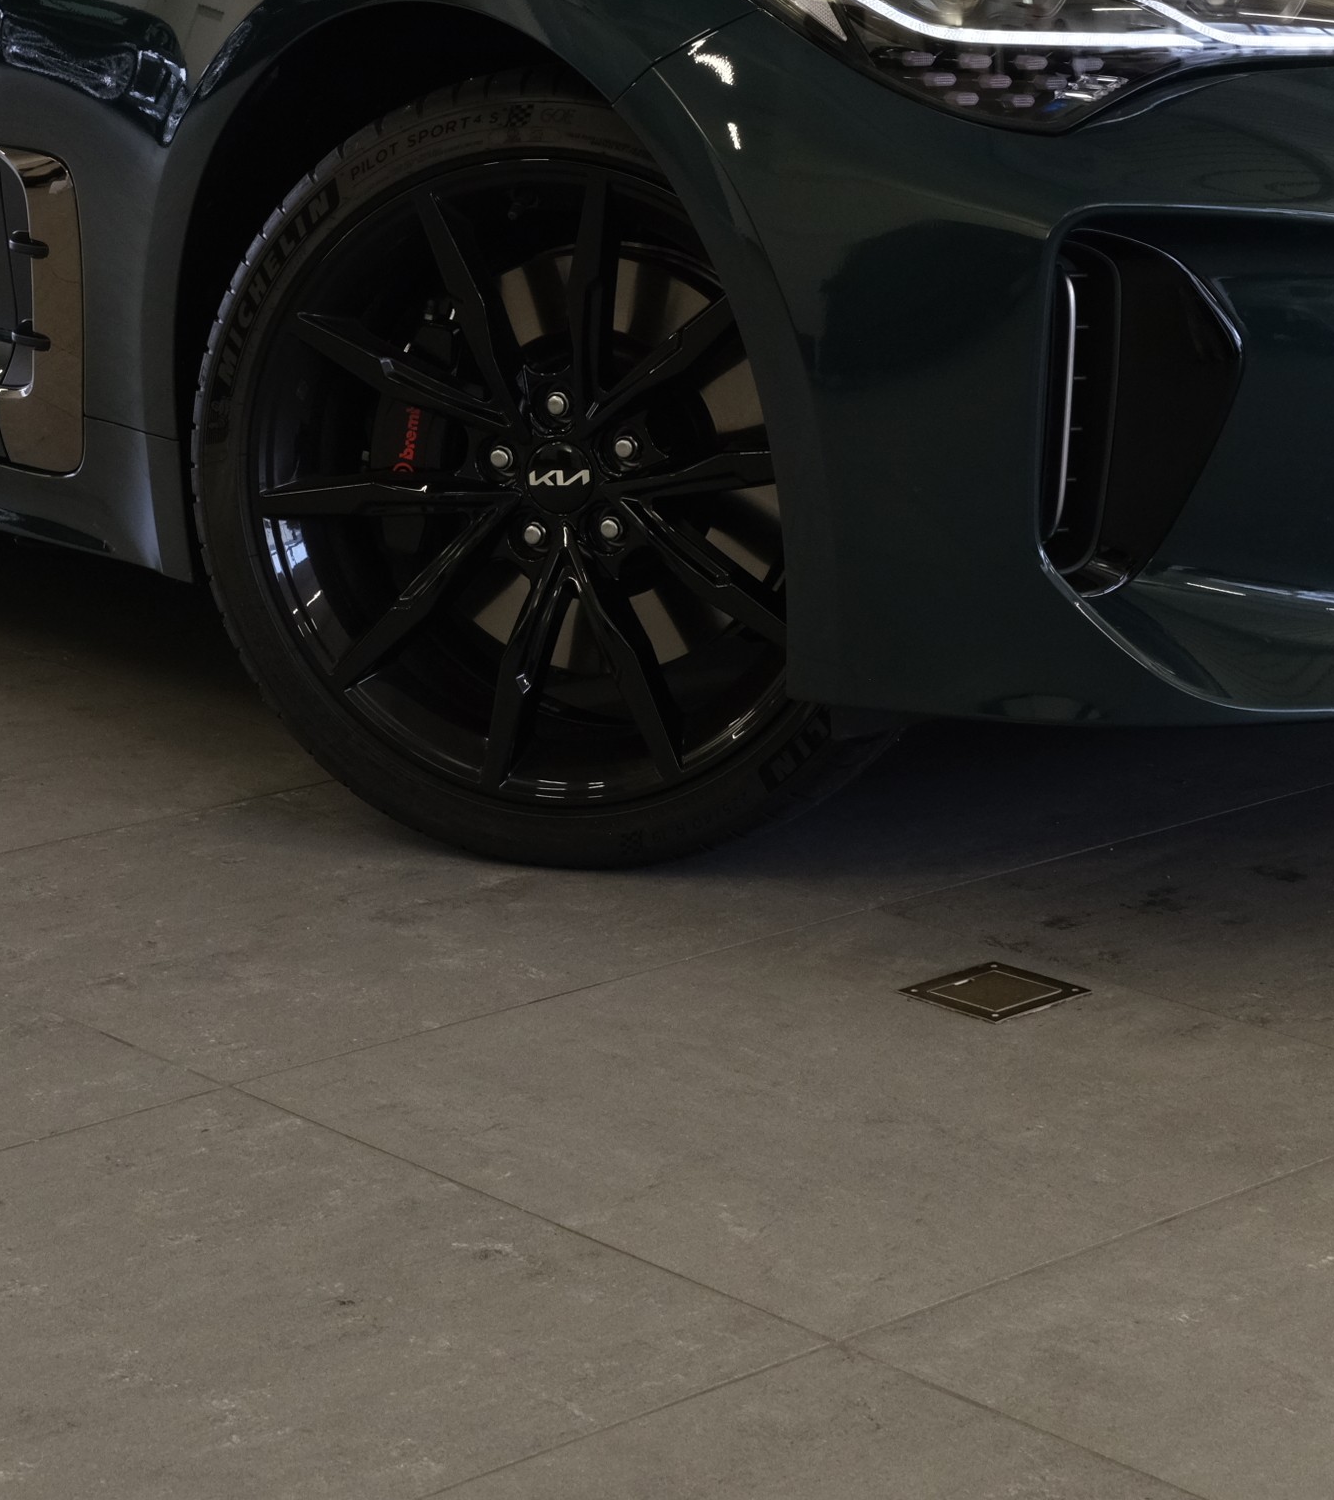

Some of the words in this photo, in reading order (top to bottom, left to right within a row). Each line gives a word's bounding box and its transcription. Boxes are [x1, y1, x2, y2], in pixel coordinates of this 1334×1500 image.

[349, 142, 400, 181] PILOT
[407, 115, 470, 148] SPORT
[216, 191, 332, 388] MICHELIN
